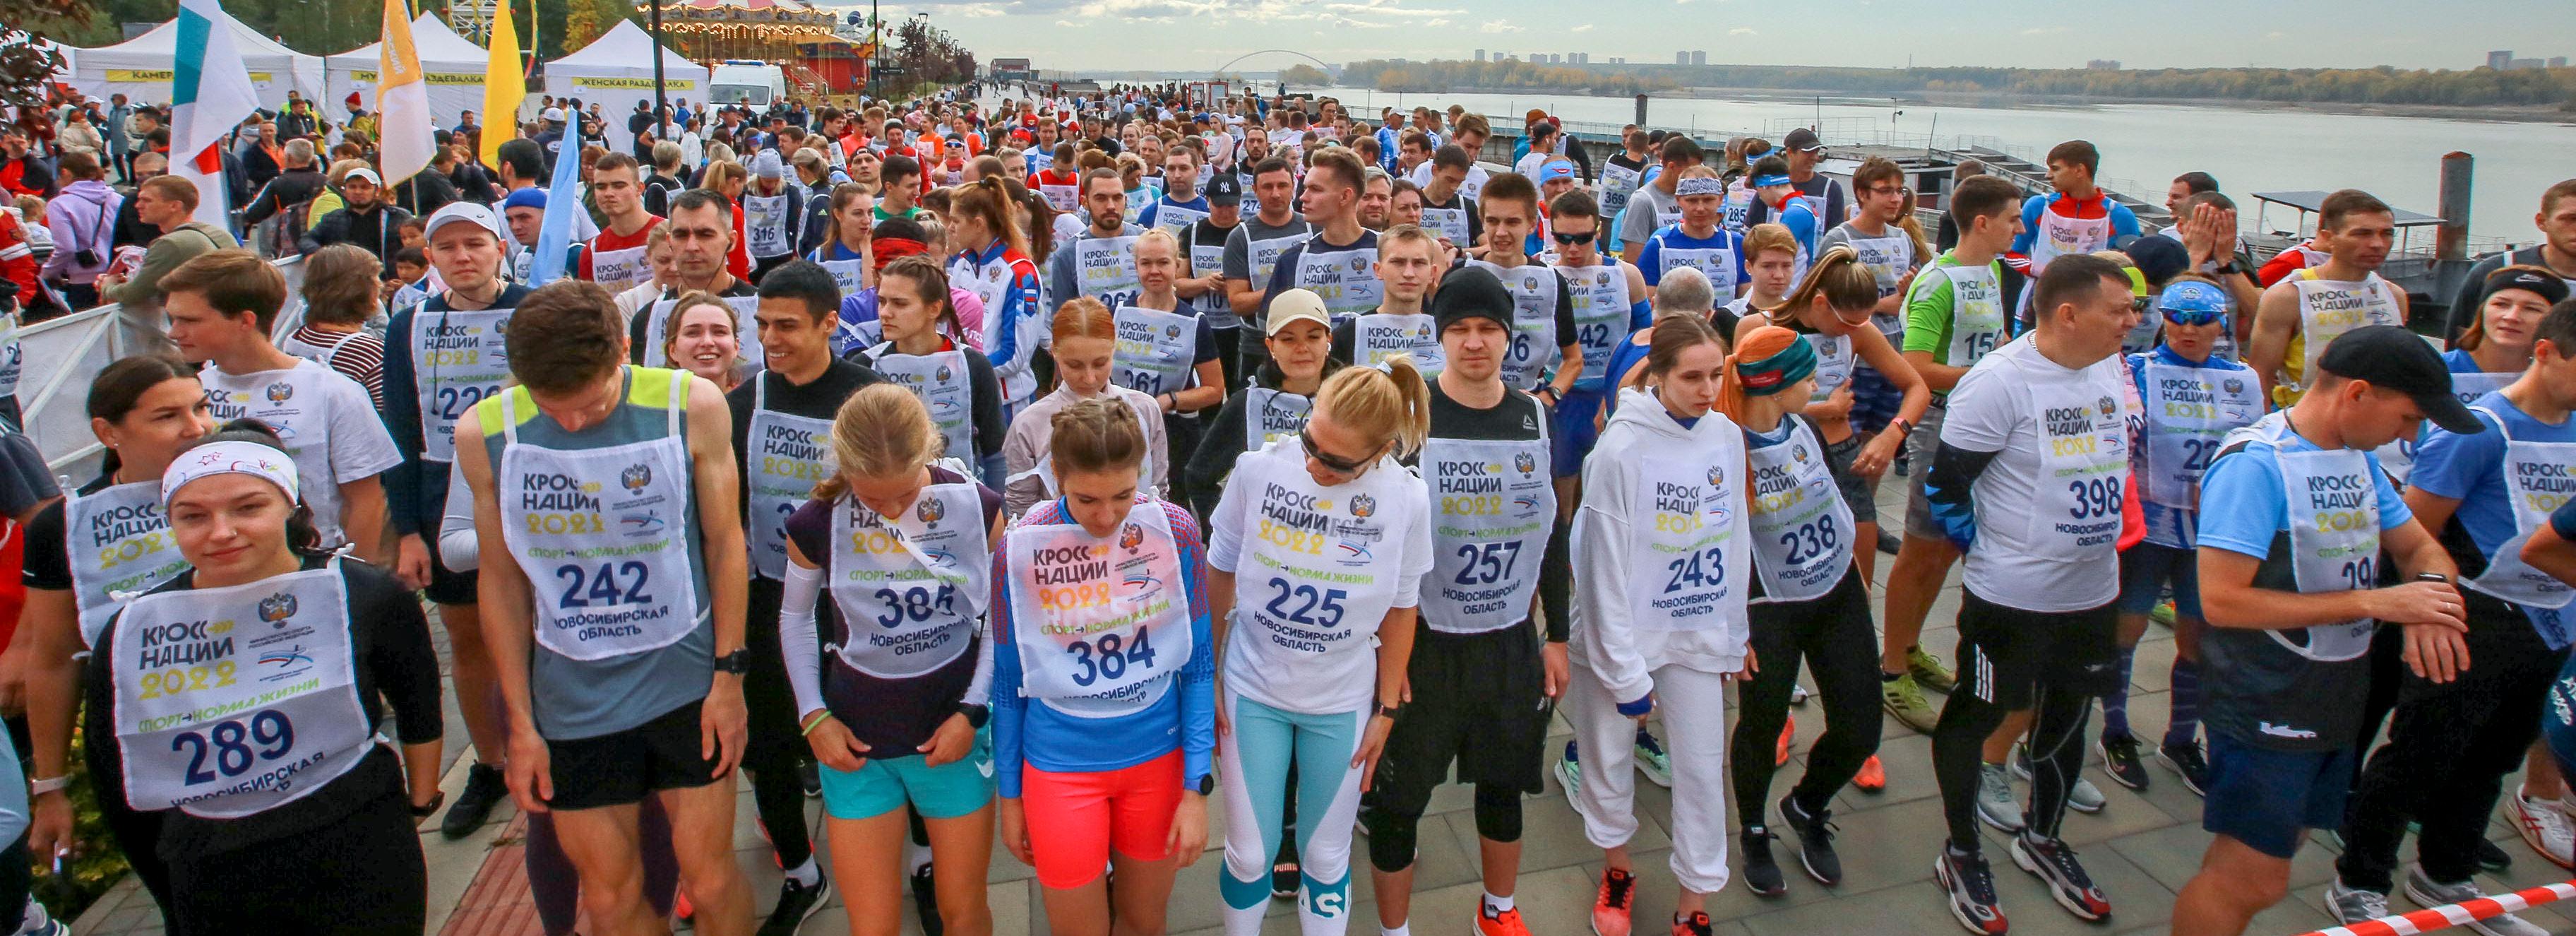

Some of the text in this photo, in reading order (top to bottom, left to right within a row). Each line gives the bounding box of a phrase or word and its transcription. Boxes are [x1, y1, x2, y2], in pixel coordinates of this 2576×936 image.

[1604, 191, 1624, 205] 369
[1728, 208, 1746, 223] 285
[753, 227, 775, 242] 316
[1084, 250, 1110, 259] КРОСС
[1085, 258, 1120, 268] НАЦИИ
[1258, 256, 1278, 265] НАЦ
[596, 263, 623, 273] КРОСС
[597, 270, 633, 283] НАЦИИ
[1086, 267, 1121, 279] 2022
[1306, 264, 1332, 273] КРОСС
[1304, 273, 1341, 285] НАЦИИ
[1568, 287, 1589, 296] ЦИИ
[2308, 290, 2350, 302] КРОСС
[2310, 297, 2363, 312] НАЦИИ
[1119, 321, 1148, 333] КРОСС
[1367, 326, 1403, 338] КРОСС
[1579, 324, 1609, 348] 42
[424, 336, 479, 350] НАЦИИ
[1118, 330, 1155, 343] НАЦИИ
[1367, 338, 1414, 349] НАЦИИ
[1964, 328, 2002, 360] 15
[1115, 340, 1153, 356] 2022
[425, 350, 479, 367] 2022
[2160, 378, 2200, 391] КРОСС
[203, 389, 232, 403] РОСС
[2161, 391, 2214, 404] НАЦИИ
[2046, 407, 2082, 422] КРОСС
[2164, 402, 2217, 419] 2022
[766, 424, 812, 445] КРОСС
[2047, 420, 2093, 437] НАЦИИ
[763, 439, 825, 461] НАЦИИ
[2052, 434, 2097, 457] 2022
[762, 456, 823, 480] 2022
[1438, 461, 1486, 476] КРОСС
[1754, 464, 1786, 483] РОСС
[2516, 462, 2567, 478] КРОСС
[1439, 478, 1502, 494] НАЦИИ
[1755, 473, 1801, 497] АЦИИ
[2306, 474, 2361, 492] КРОСС
[1265, 482, 1317, 511] КРОСС
[2068, 475, 2123, 520] 398
[2310, 491, 2365, 509] НАЦИ
[1441, 496, 1503, 516] 2022
[92, 502, 157, 530] КРОСС
[526, 513, 604, 535] 2022
[1260, 499, 1328, 532] НАЦИИ
[1257, 519, 1325, 556] 2022
[1780, 514, 1836, 566] 238
[2077, 533, 2113, 547] ОБЛАСТЬ
[527, 547, 566, 559] СПОРТ
[1033, 545, 1091, 566] КРОСС
[1253, 552, 1373, 586] СПОРТ НОРМА ЖИЗНИ
[1455, 540, 1522, 586] 257
[1664, 547, 1724, 594] 243
[849, 569, 886, 581] СПОРТ
[1034, 560, 1108, 585] НАЦИИ
[556, 561, 652, 609] 242
[1443, 579, 1521, 602] НОВОСИБИРСКАЯ
[1039, 582, 1111, 611] 2022
[1265, 576, 1347, 629] 225
[1652, 586, 1728, 609] НОВОСИБИРСКАЯ
[1463, 600, 1507, 615] ОБЛАСТЬ
[1671, 605, 1714, 617] ОБЛАСТЬ
[141, 620, 208, 648] КРОСС
[578, 628, 641, 641] ОБЛАСТЬ
[1039, 620, 1075, 636] СПОРТ
[1085, 615, 1130, 634] НОРМА
[1254, 610, 1352, 643] НОВОСИБИРСКАЯ
[138, 635, 235, 670] НАЦИИ
[895, 632, 951, 656] ОБЛАСТЬ
[1272, 634, 1326, 653] ОБЛАСТЬ
[1067, 624, 1157, 687] 384
[138, 660, 237, 701] 2022
[138, 677, 320, 734] СПОРТ НОРМА ЖИЗНИ
[171, 709, 294, 787] 289
[1273, 863, 1299, 873] PUMA
